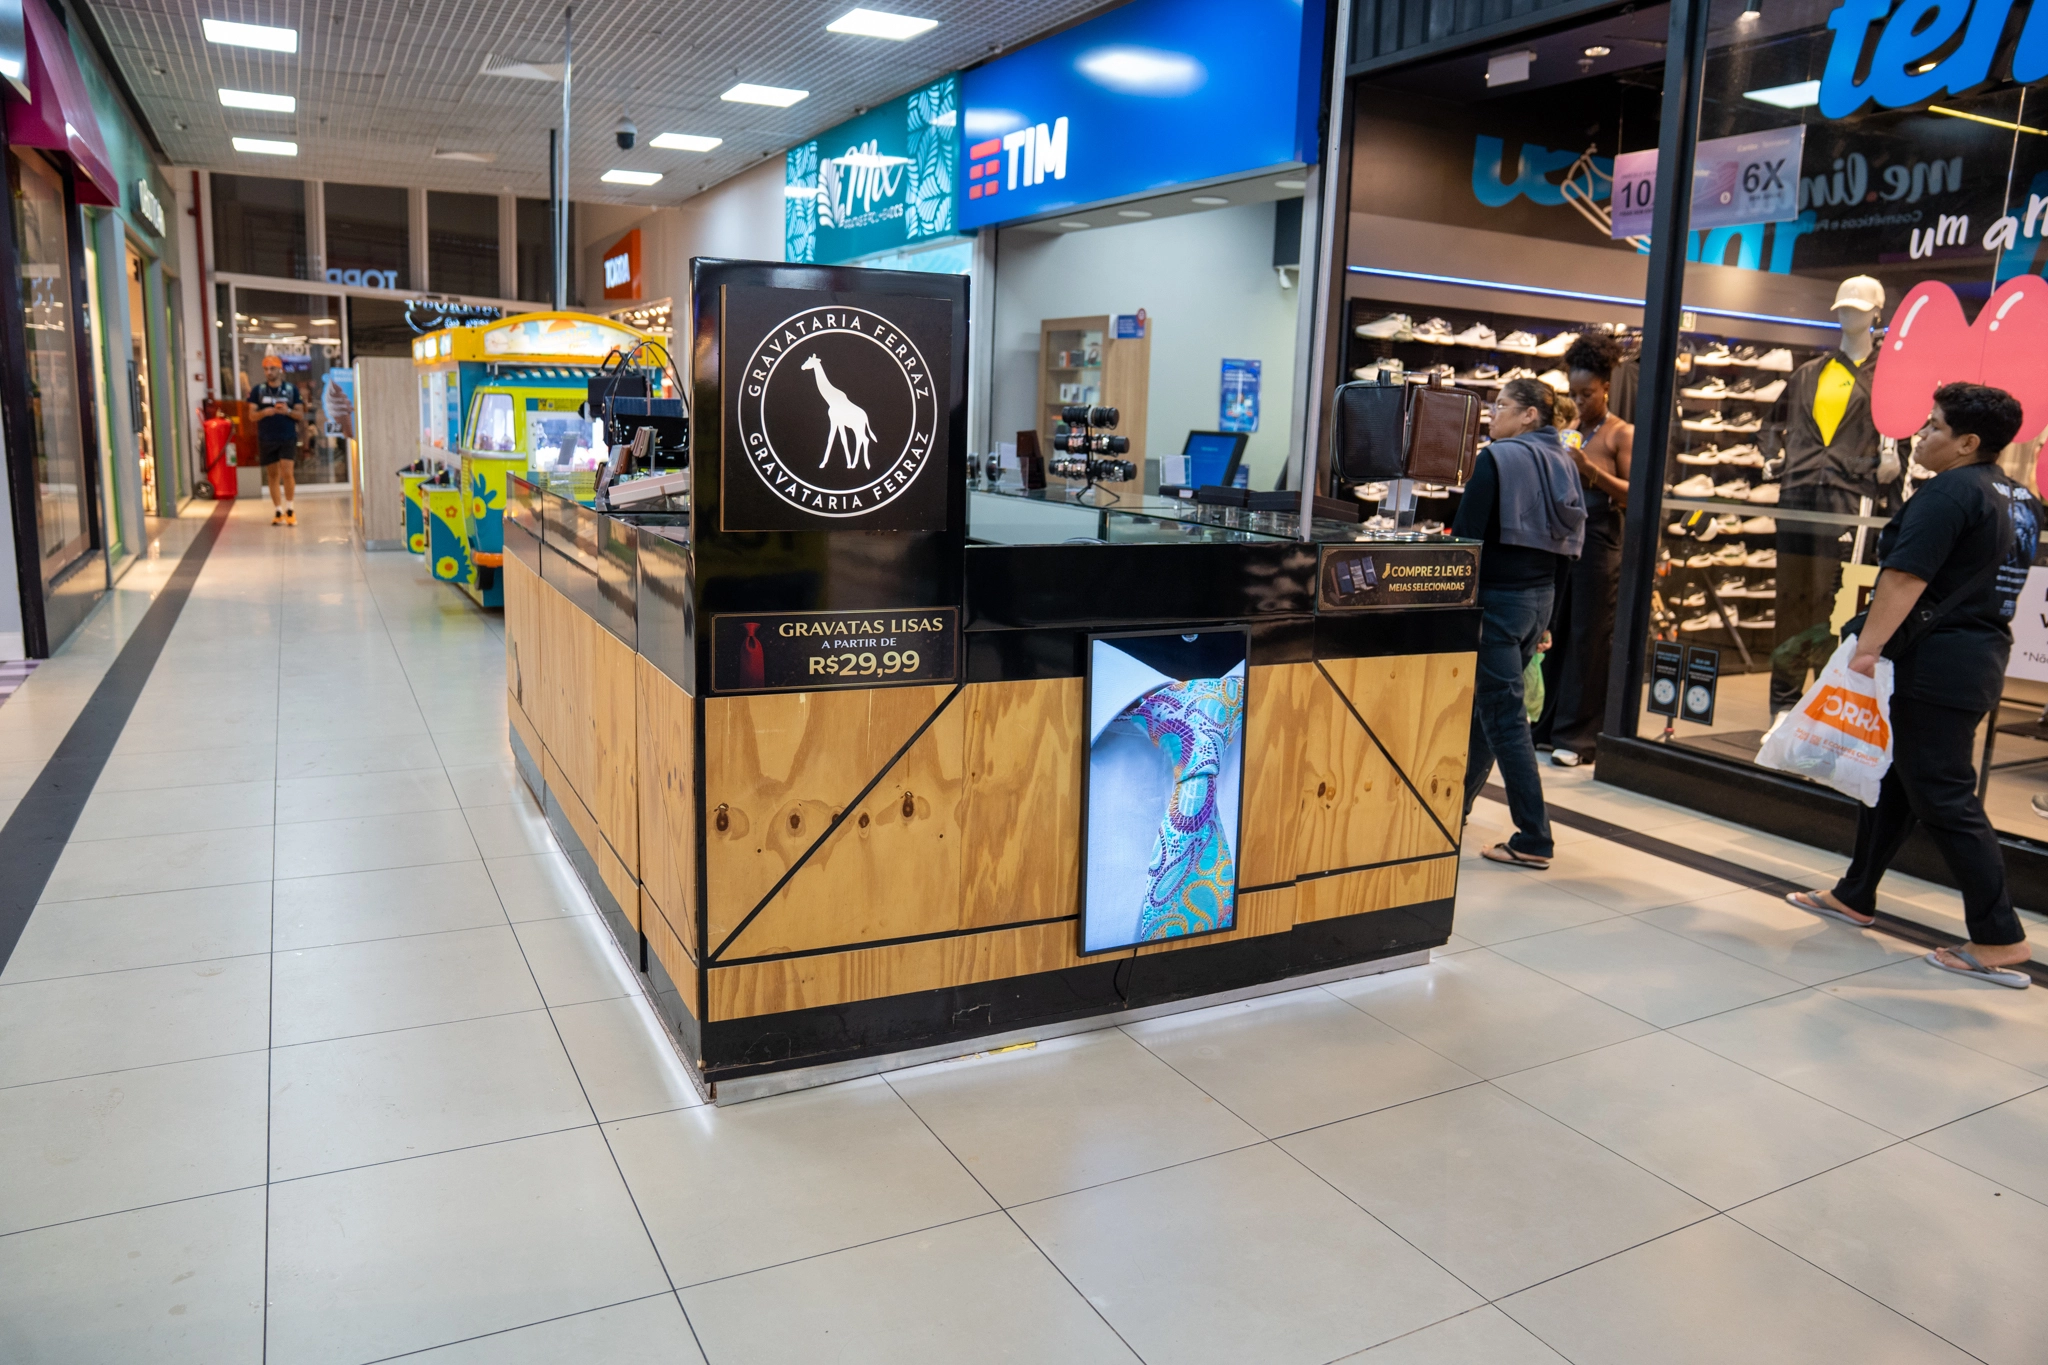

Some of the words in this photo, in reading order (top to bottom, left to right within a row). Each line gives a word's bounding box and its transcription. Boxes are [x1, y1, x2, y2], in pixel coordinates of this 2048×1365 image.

[1003, 116, 1069, 191] TIM
[1743, 159, 1786, 194] 6X
[1909, 213, 1969, 259] um
[748, 313, 861, 397] GRAVATARIA
[873, 324, 929, 400] FERRAZ
[750, 432, 863, 510] GRAVATARIA
[873, 431, 929, 501] FERRAZ
[1388, 583, 1412, 592] MEIAS
[1412, 582, 1465, 592] SELECIONADAS
[1391, 565, 1433, 578] COMPRE
[1434, 565, 1440, 576] 2
[1441, 565, 1464, 577] LEVE
[1465, 565, 1472, 576] 3
[778, 619, 885, 638] GRAVATAS
[891, 617, 944, 633] LISAS
[821, 640, 831, 649] A
[834, 638, 876, 649] PARTIR
[880, 637, 897, 647] DE
[808, 650, 920, 678] R$29,99
